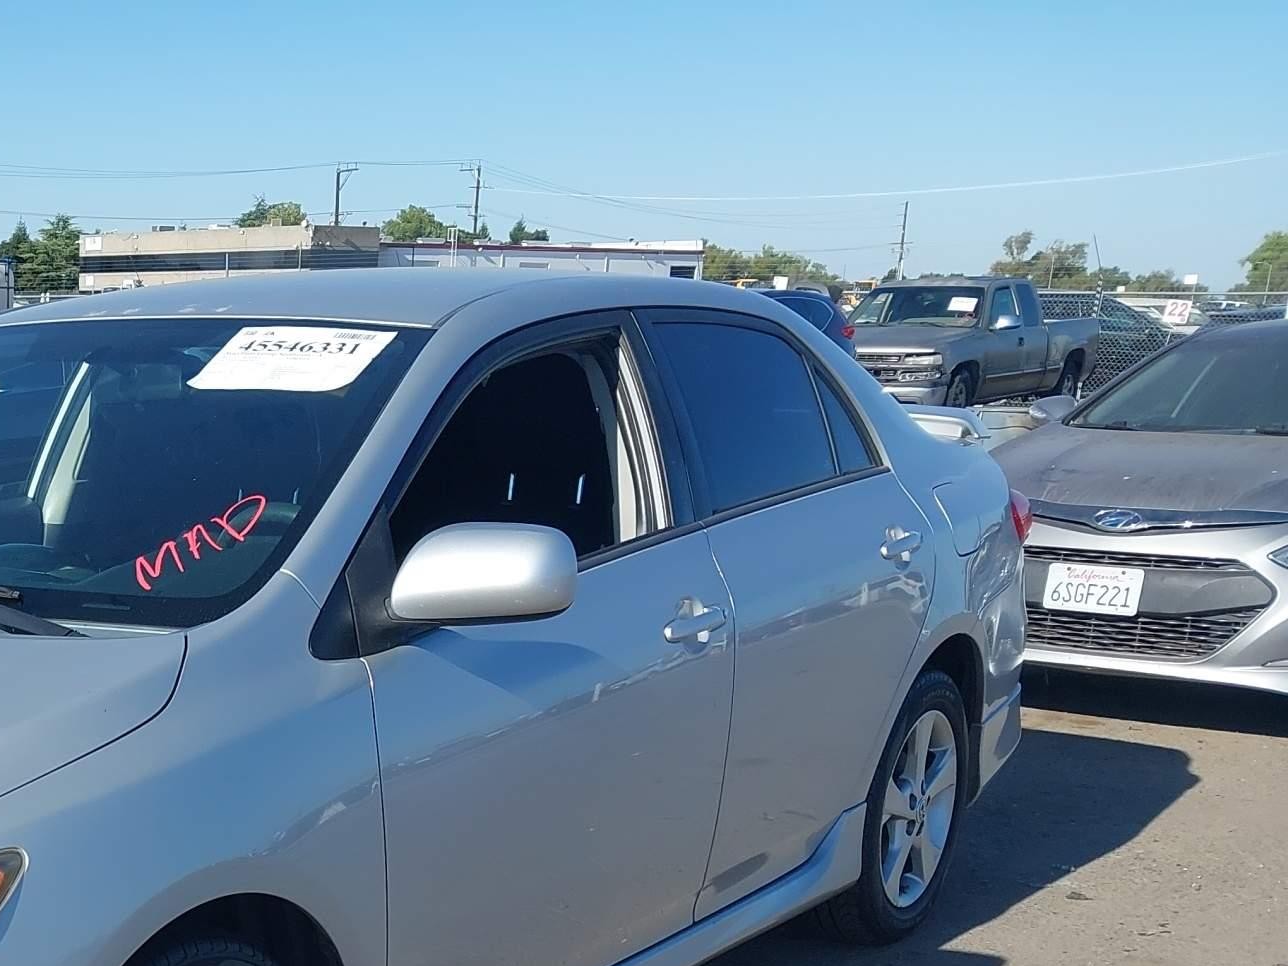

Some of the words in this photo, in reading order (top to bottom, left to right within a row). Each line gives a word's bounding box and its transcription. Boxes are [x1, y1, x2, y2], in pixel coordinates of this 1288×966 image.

[1168, 302, 1188, 317] 22
[239, 339, 361, 355] 45546331
[1050, 581, 1131, 608] 6SGF221
